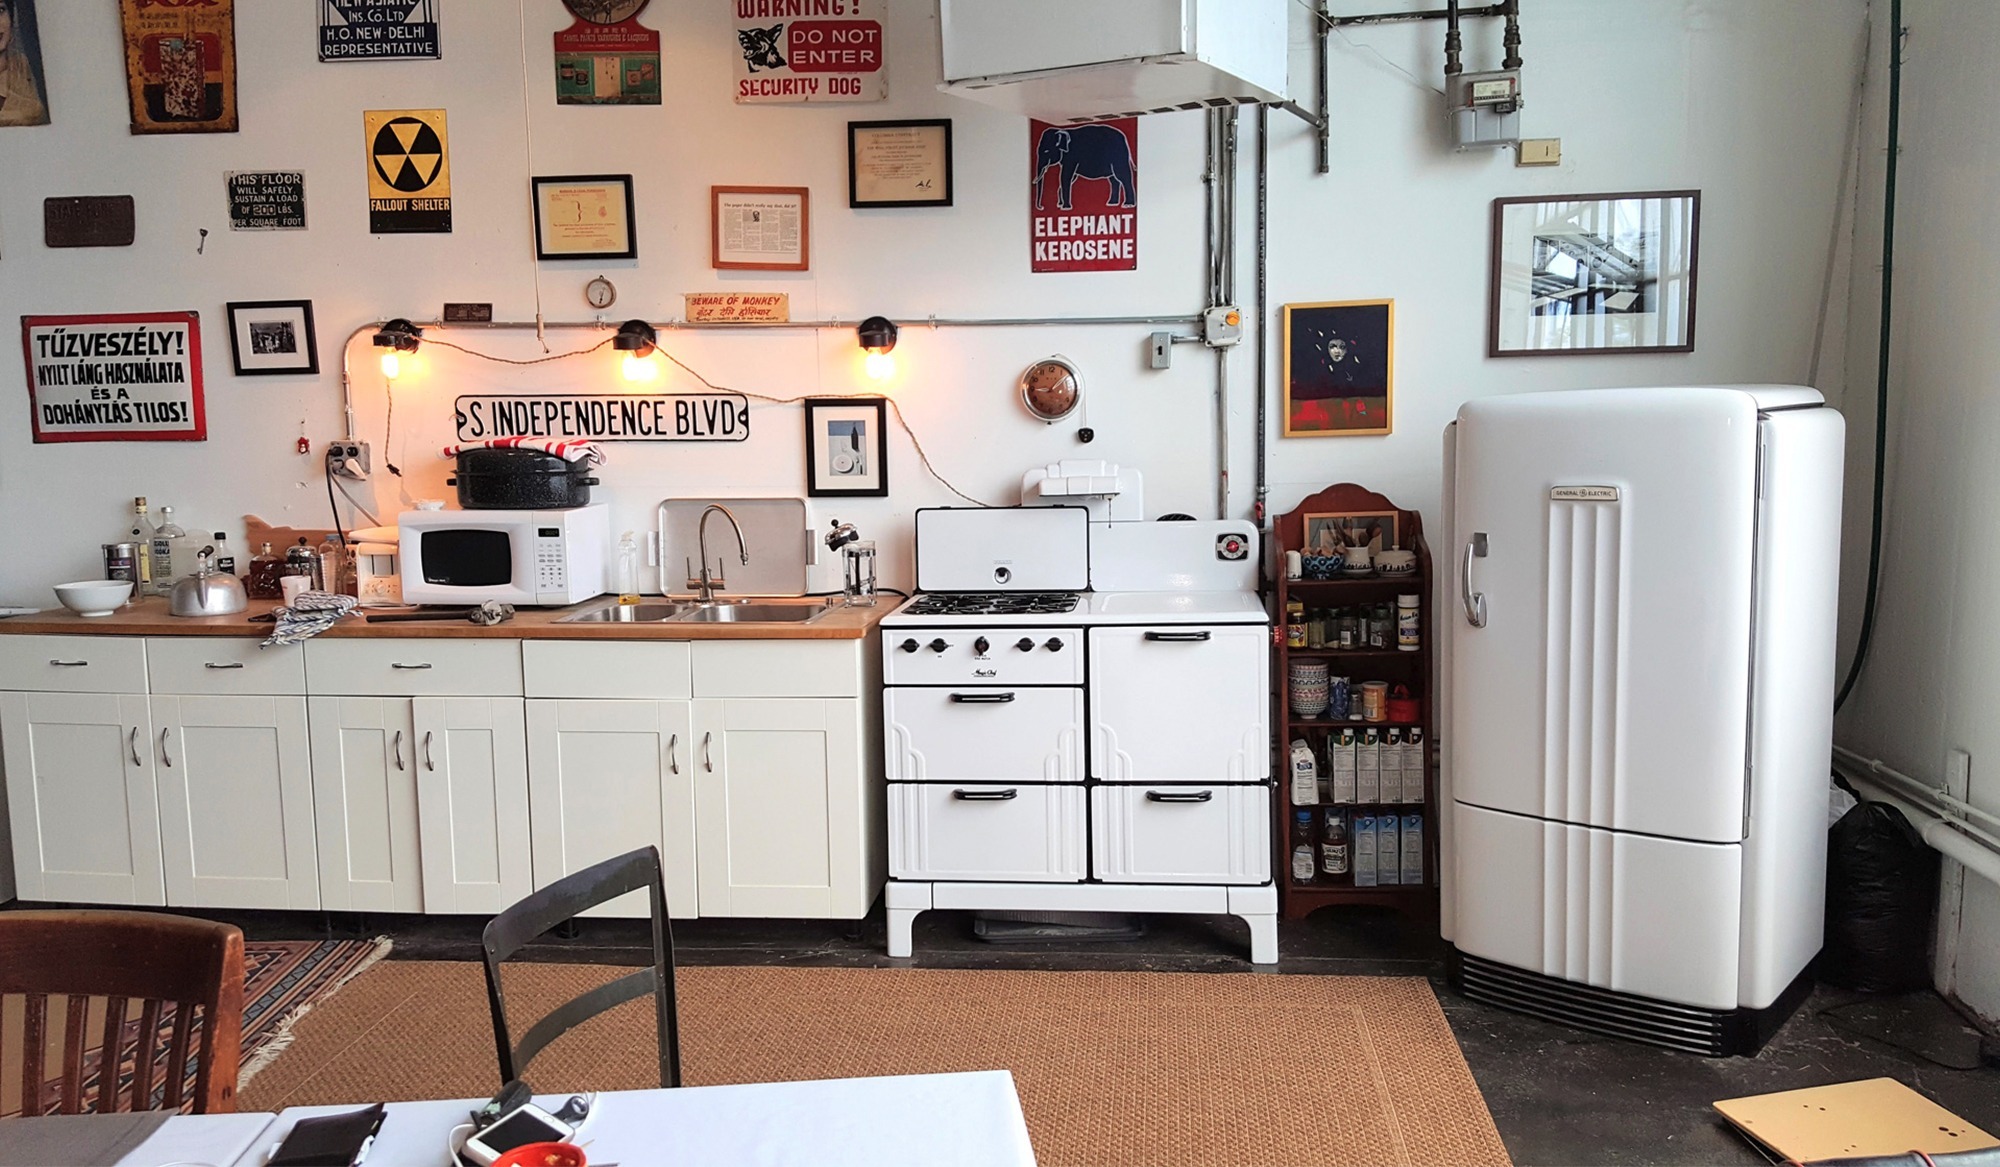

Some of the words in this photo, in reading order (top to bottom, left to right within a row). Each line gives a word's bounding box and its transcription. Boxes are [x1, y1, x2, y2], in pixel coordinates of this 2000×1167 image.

[327, 28, 353, 40] H.O.
[793, 30, 823, 44] DO
[833, 29, 877, 43] NOT
[325, 42, 433, 55] REPRESENTATIVE
[793, 50, 876, 64] ENTER
[740, 78, 819, 96] SECURITY
[829, 78, 861, 95] DOG
[232, 174, 256, 185] THIS
[261, 174, 301, 185] FLOOR
[237, 186, 258, 195] WILL
[235, 195, 266, 204] SUSTAIN
[269, 195, 275, 203] A
[277, 195, 298, 203] LOAD
[371, 199, 408, 211] FALLOUT
[412, 199, 450, 211] SHELTER
[241, 205, 251, 214] OF
[253, 205, 276, 216] 200
[249, 218, 279, 227] SQUARE
[282, 218, 302, 227] FOOT
[1035, 214, 1134, 237] ELEPHANT
[1035, 239, 1134, 261] KEROSENE
[692, 296, 724, 306] BEWARE
[727, 296, 739, 305] OF
[742, 296, 780, 306] MONKEY
[37, 326, 184, 358] TŰZVESZÉLY!
[38, 363, 69, 386] NYILT
[71, 358, 103, 386] LÁNG
[105, 357, 185, 384] HASZNÁLATA
[91, 386, 111, 400] ÉS
[117, 388, 130, 399] A
[43, 399, 132, 425] DOHÁNYZÁS
[133, 401, 188, 424] TILOS!
[469, 400, 491, 436] S.
[492, 400, 666, 436] INDEPENDENCE
[676, 400, 743, 436] BLVD.
